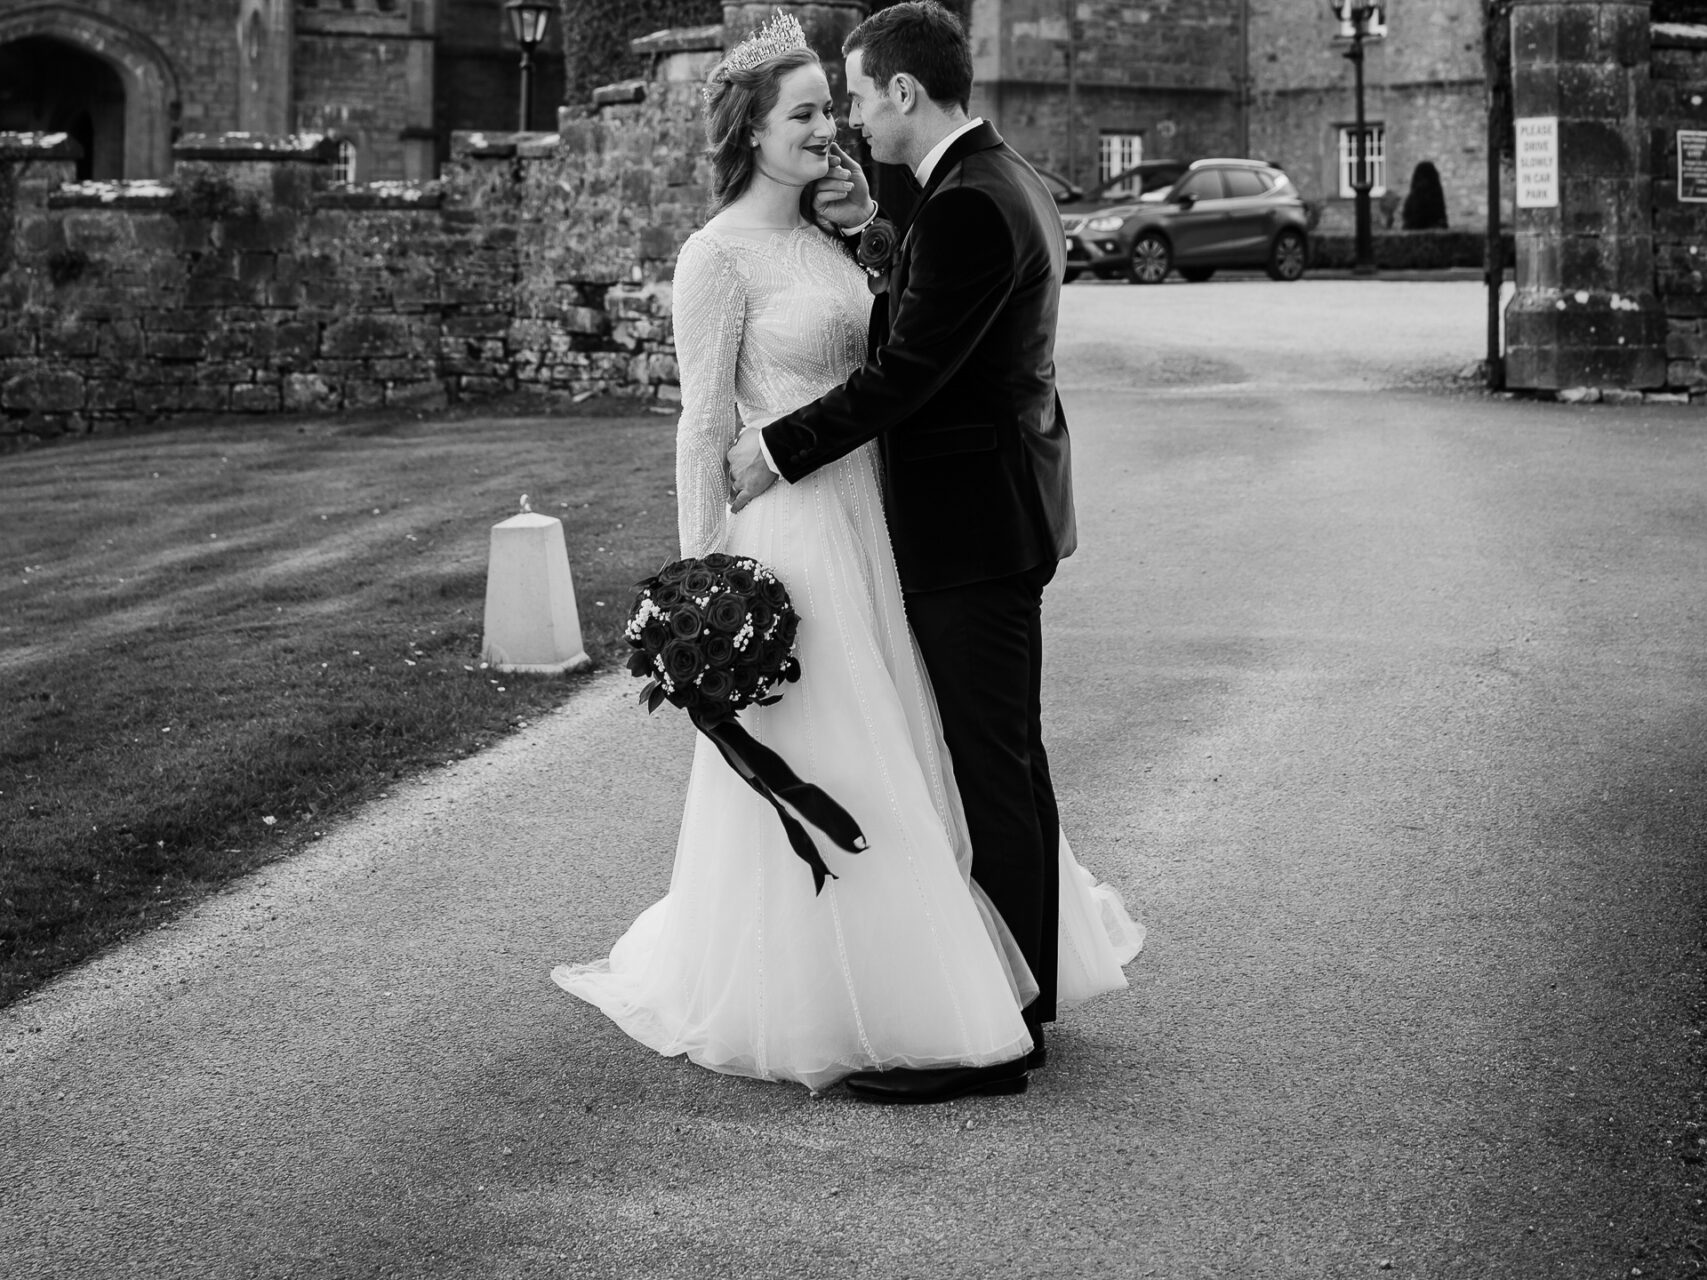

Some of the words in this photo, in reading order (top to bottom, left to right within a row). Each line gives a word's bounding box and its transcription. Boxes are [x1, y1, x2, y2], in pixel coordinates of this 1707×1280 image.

[1520, 124, 1553, 136] PLEASE
[1524, 141, 1549, 152] DRIVE
[1520, 157, 1553, 168] SLOWLY
[1522, 174, 1532, 184] IN
[1533, 173, 1551, 184] CAR
[1525, 190, 1548, 200] PARK
